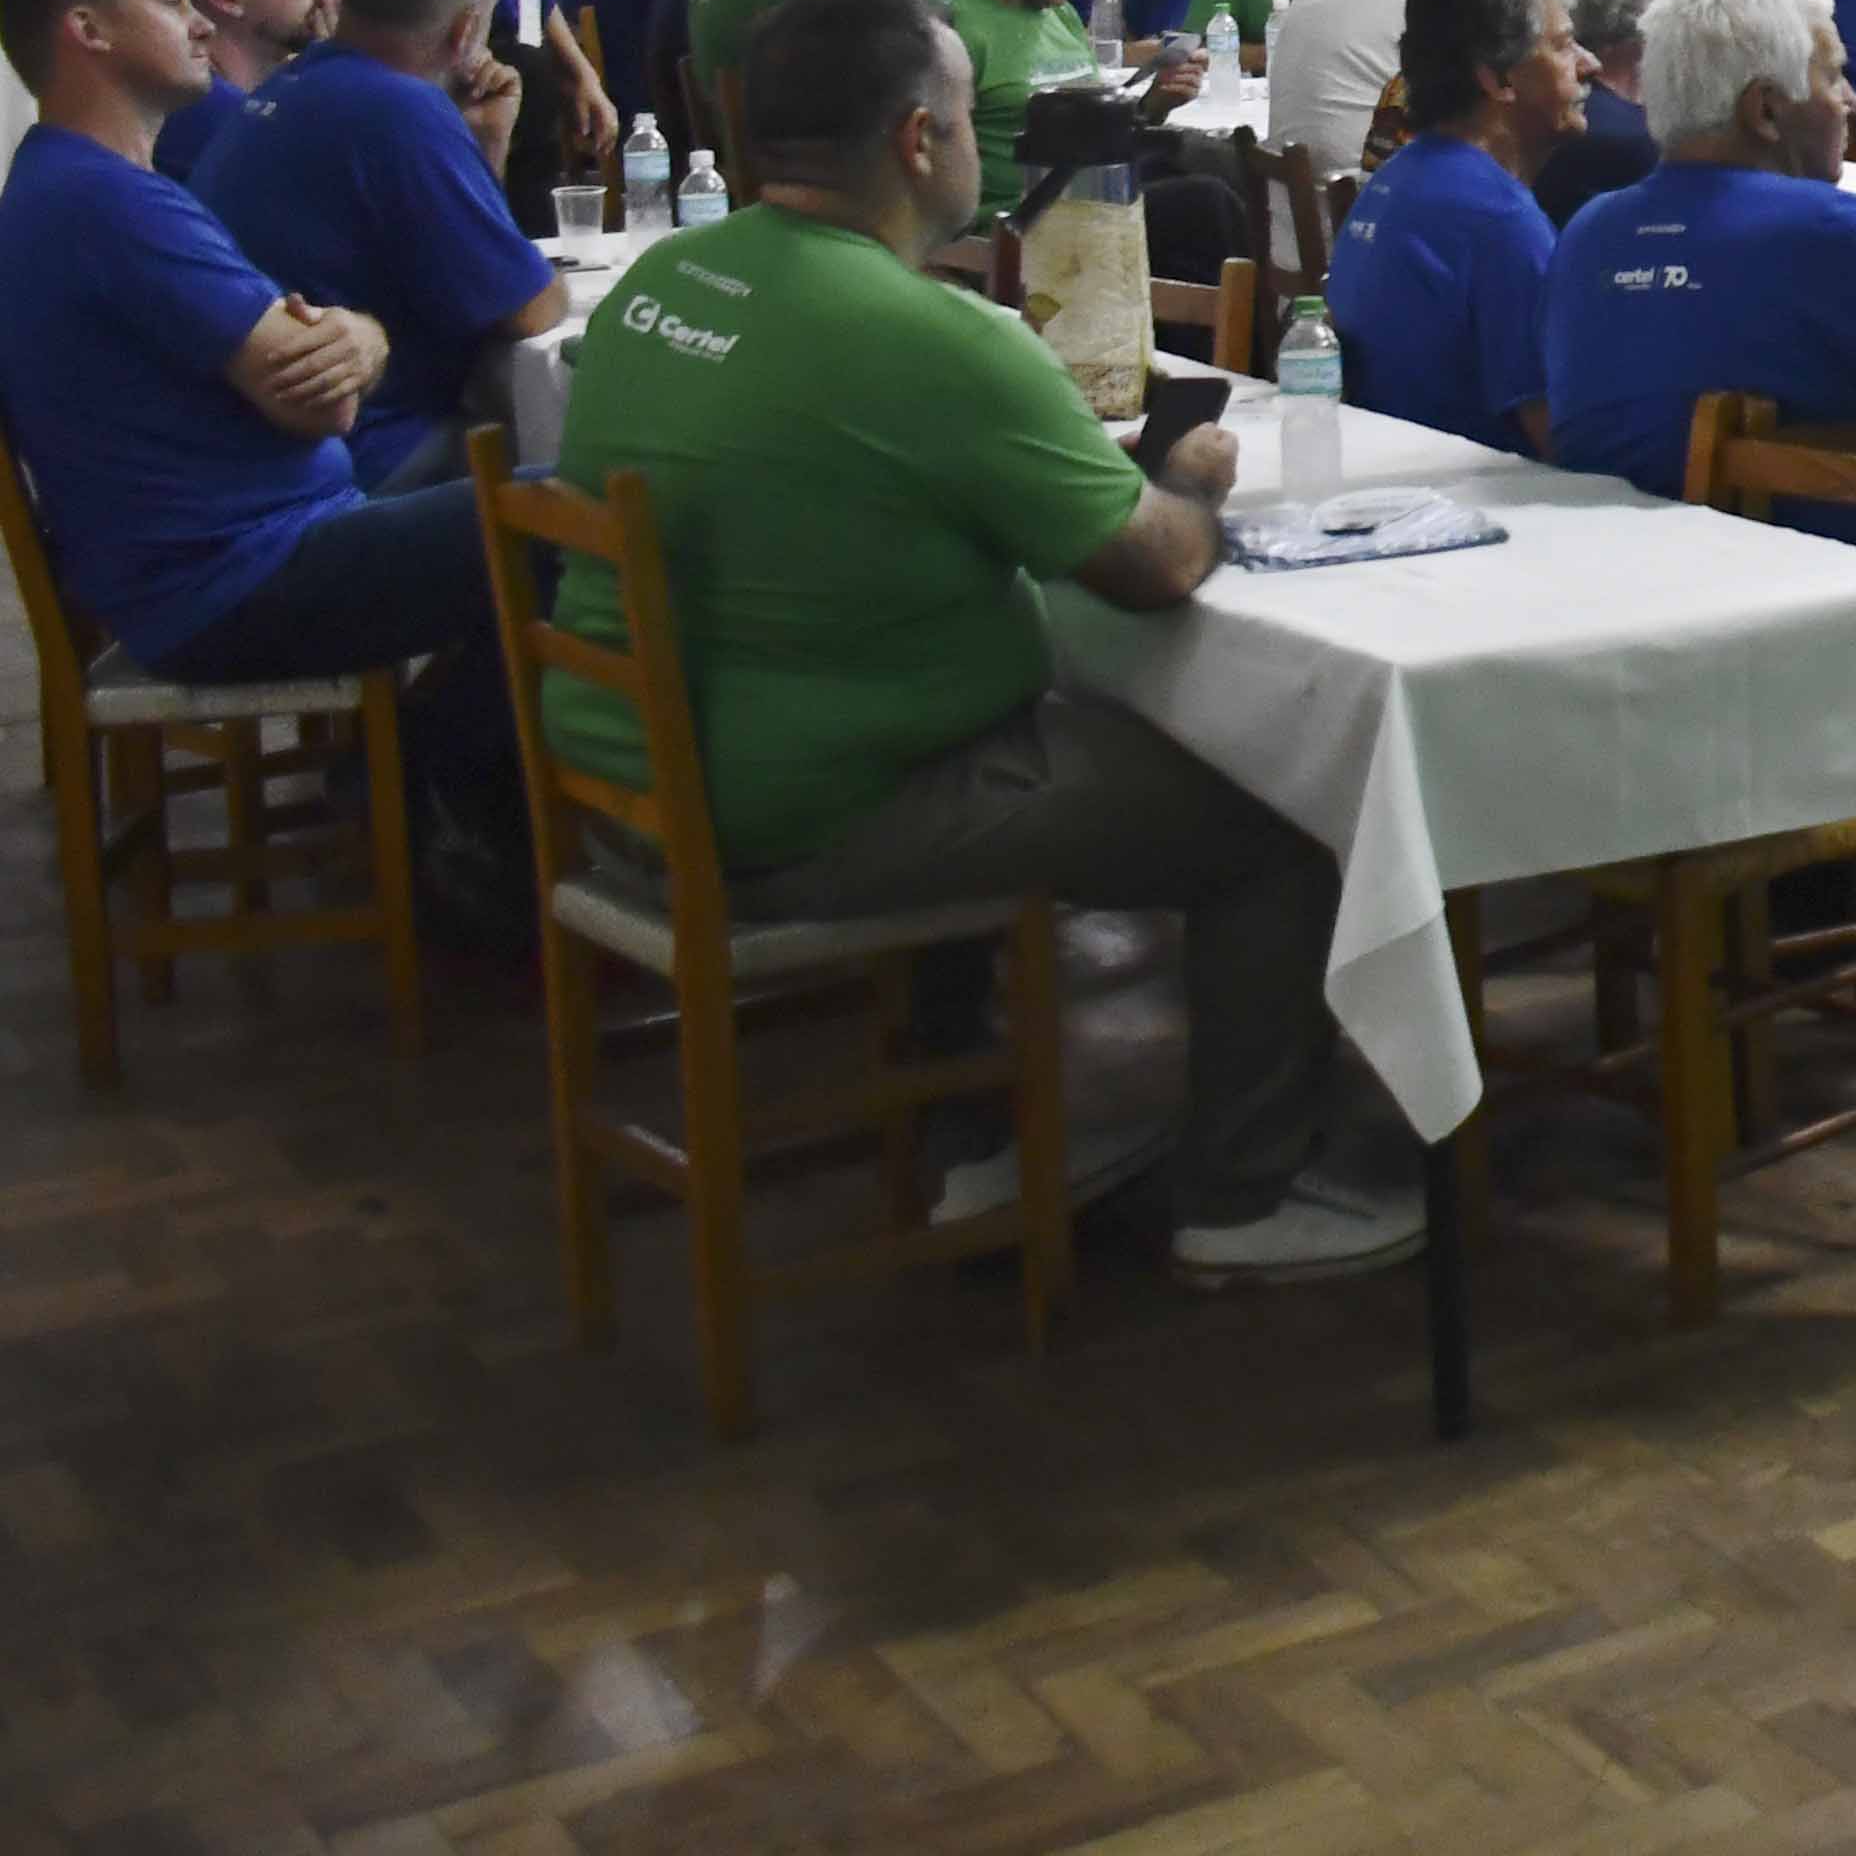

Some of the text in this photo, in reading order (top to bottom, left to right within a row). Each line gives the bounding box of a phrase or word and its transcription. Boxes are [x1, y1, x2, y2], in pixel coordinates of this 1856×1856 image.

[1614, 265, 1689, 288] certel 70
[658, 314, 741, 354] Certel
